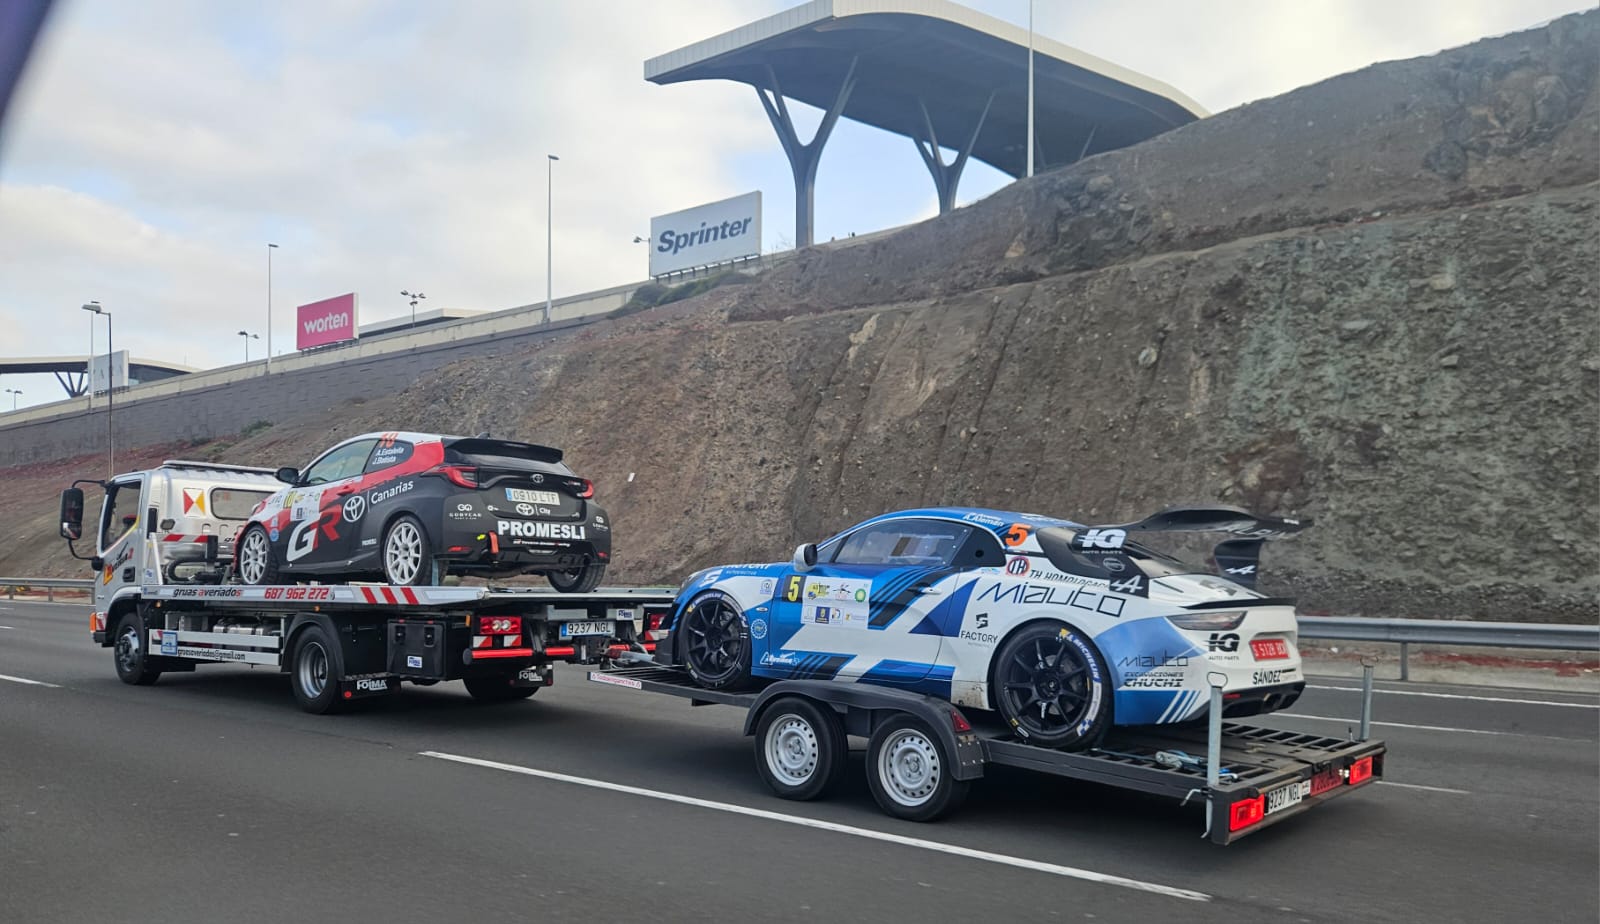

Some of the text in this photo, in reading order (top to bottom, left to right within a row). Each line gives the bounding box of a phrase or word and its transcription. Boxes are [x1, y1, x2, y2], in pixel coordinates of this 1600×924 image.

[657, 216, 752, 255] Sprinter
[304, 311, 349, 336] worten
[370, 480, 414, 505] Canarias
[512, 489, 538, 501] 0910
[286, 504, 343, 562] GR
[497, 520, 586, 540] PROMESLI
[1005, 523, 1032, 547] 5
[173, 587, 242, 598] gruas averiados
[264, 587, 330, 600] 687 962 272
[787, 575, 801, 602] 5
[568, 622, 611, 634] 9237 NGL
[960, 630, 998, 644] FACTORY
[1204, 633, 1241, 652] IG
[1123, 678, 1184, 688] CHUCHI
[1269, 786, 1287, 809] 9237
[1288, 783, 1300, 801] NGL
